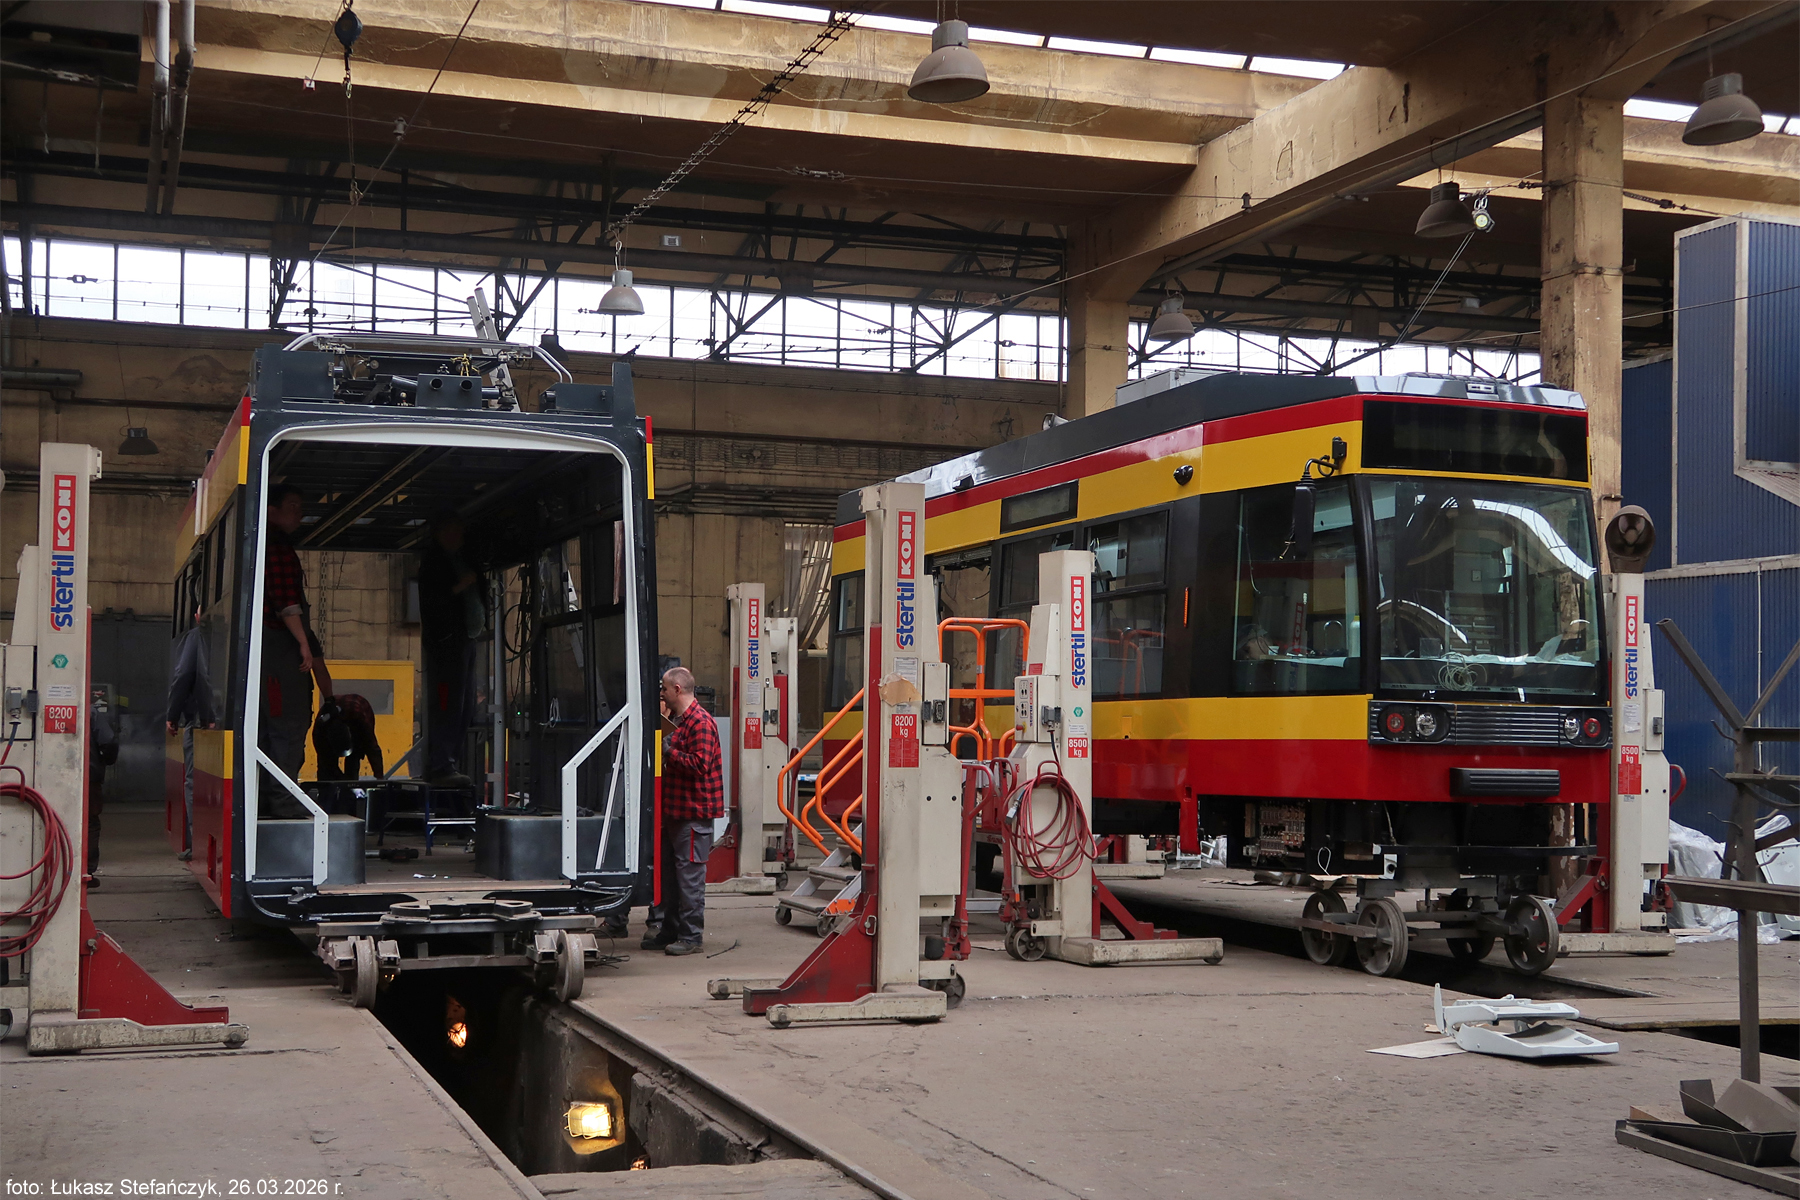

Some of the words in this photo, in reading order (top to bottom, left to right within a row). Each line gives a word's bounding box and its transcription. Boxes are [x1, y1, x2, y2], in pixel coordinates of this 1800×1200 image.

[57, 479, 71, 547] KONI
[901, 515, 912, 575] KONI
[51, 555, 74, 631] stertil
[1073, 579, 1082, 628] KONI
[896, 582, 914, 650] stertil
[1627, 598, 1636, 644] KONI
[747, 639, 759, 679] stertil
[1071, 633, 1085, 688] stertil
[1625, 648, 1638, 699] stertil
[49, 707, 73, 719] 8200
[55, 720, 66, 733] kg
[894, 716, 914, 726] 8200
[899, 727, 909, 738] kg
[1068, 739, 1088, 748] 8500
[1073, 748, 1082, 758] kg
[1621, 746, 1639, 755] 8500
[1625, 755, 1634, 763] kg
